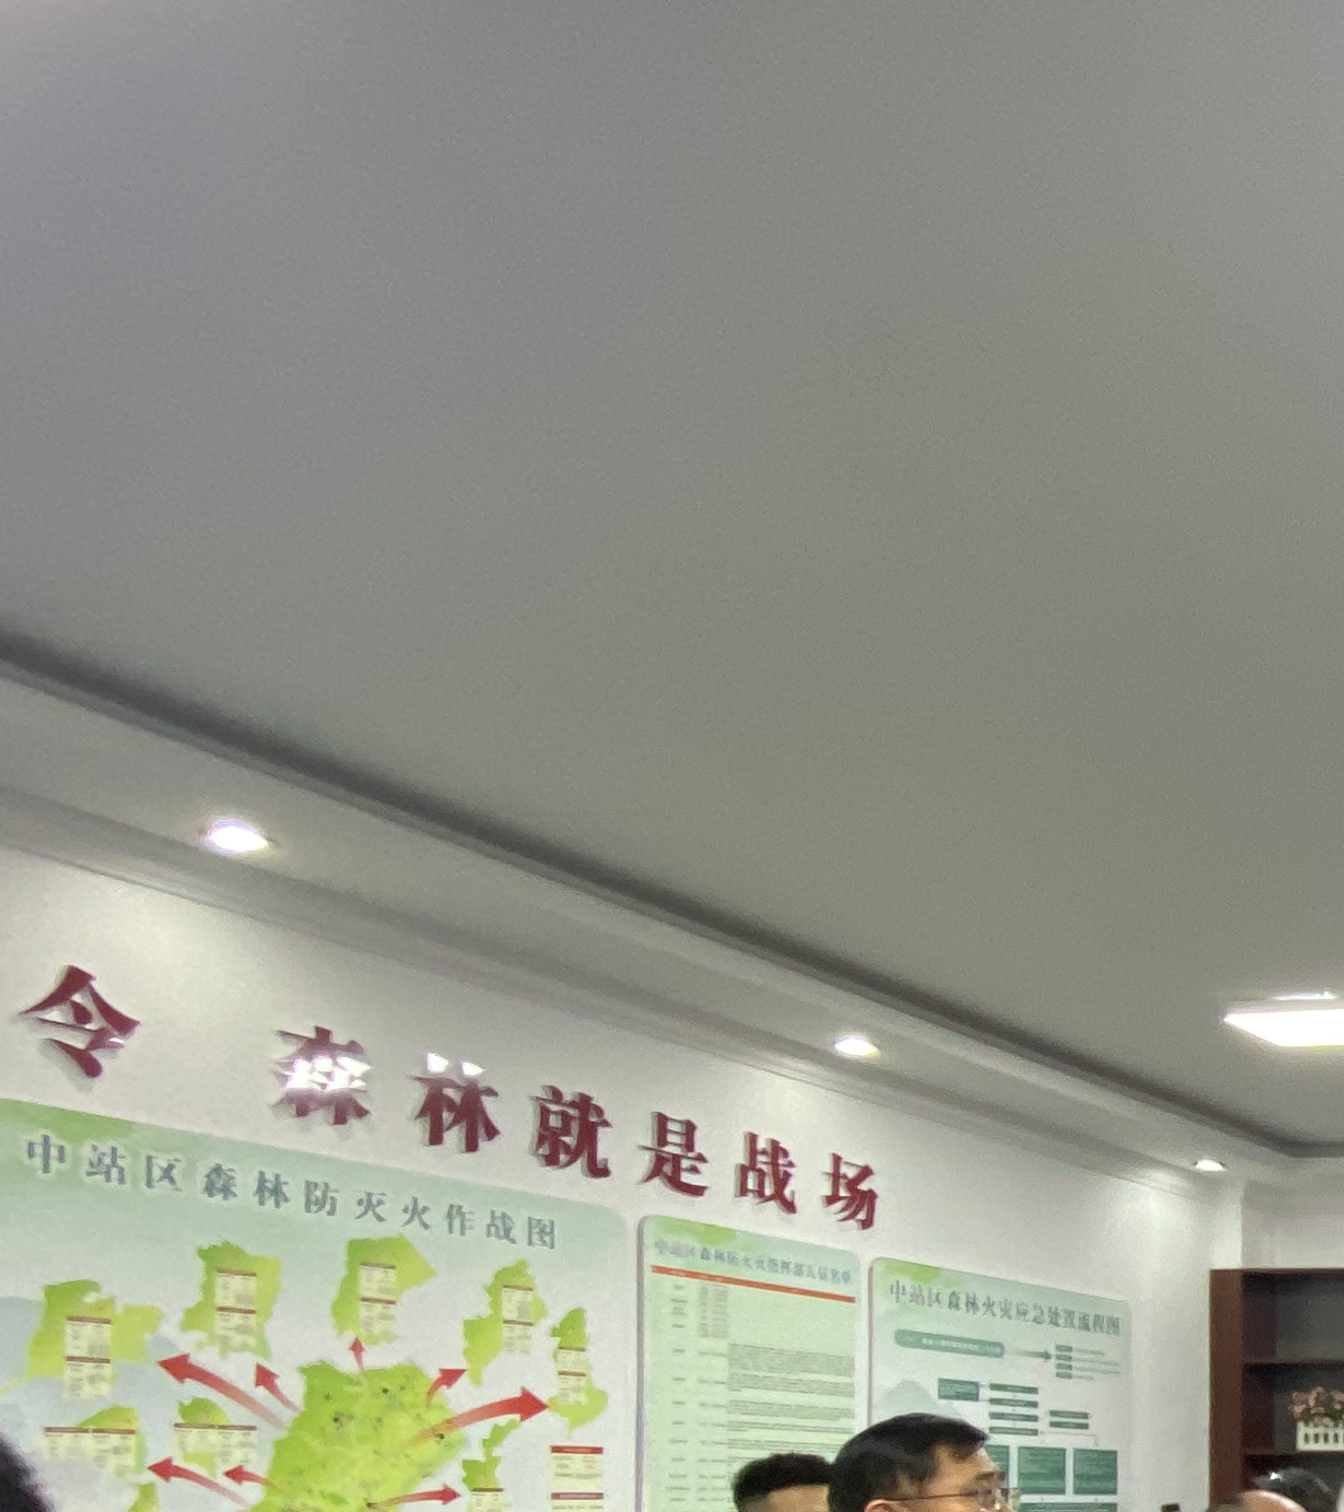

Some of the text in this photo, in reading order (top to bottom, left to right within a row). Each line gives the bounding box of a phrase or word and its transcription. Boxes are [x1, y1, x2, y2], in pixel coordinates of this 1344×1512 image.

[20, 964, 879, 1231] 令 森林就是战场
[27, 1133, 558, 1250] 中站区森林防灭火作战图
